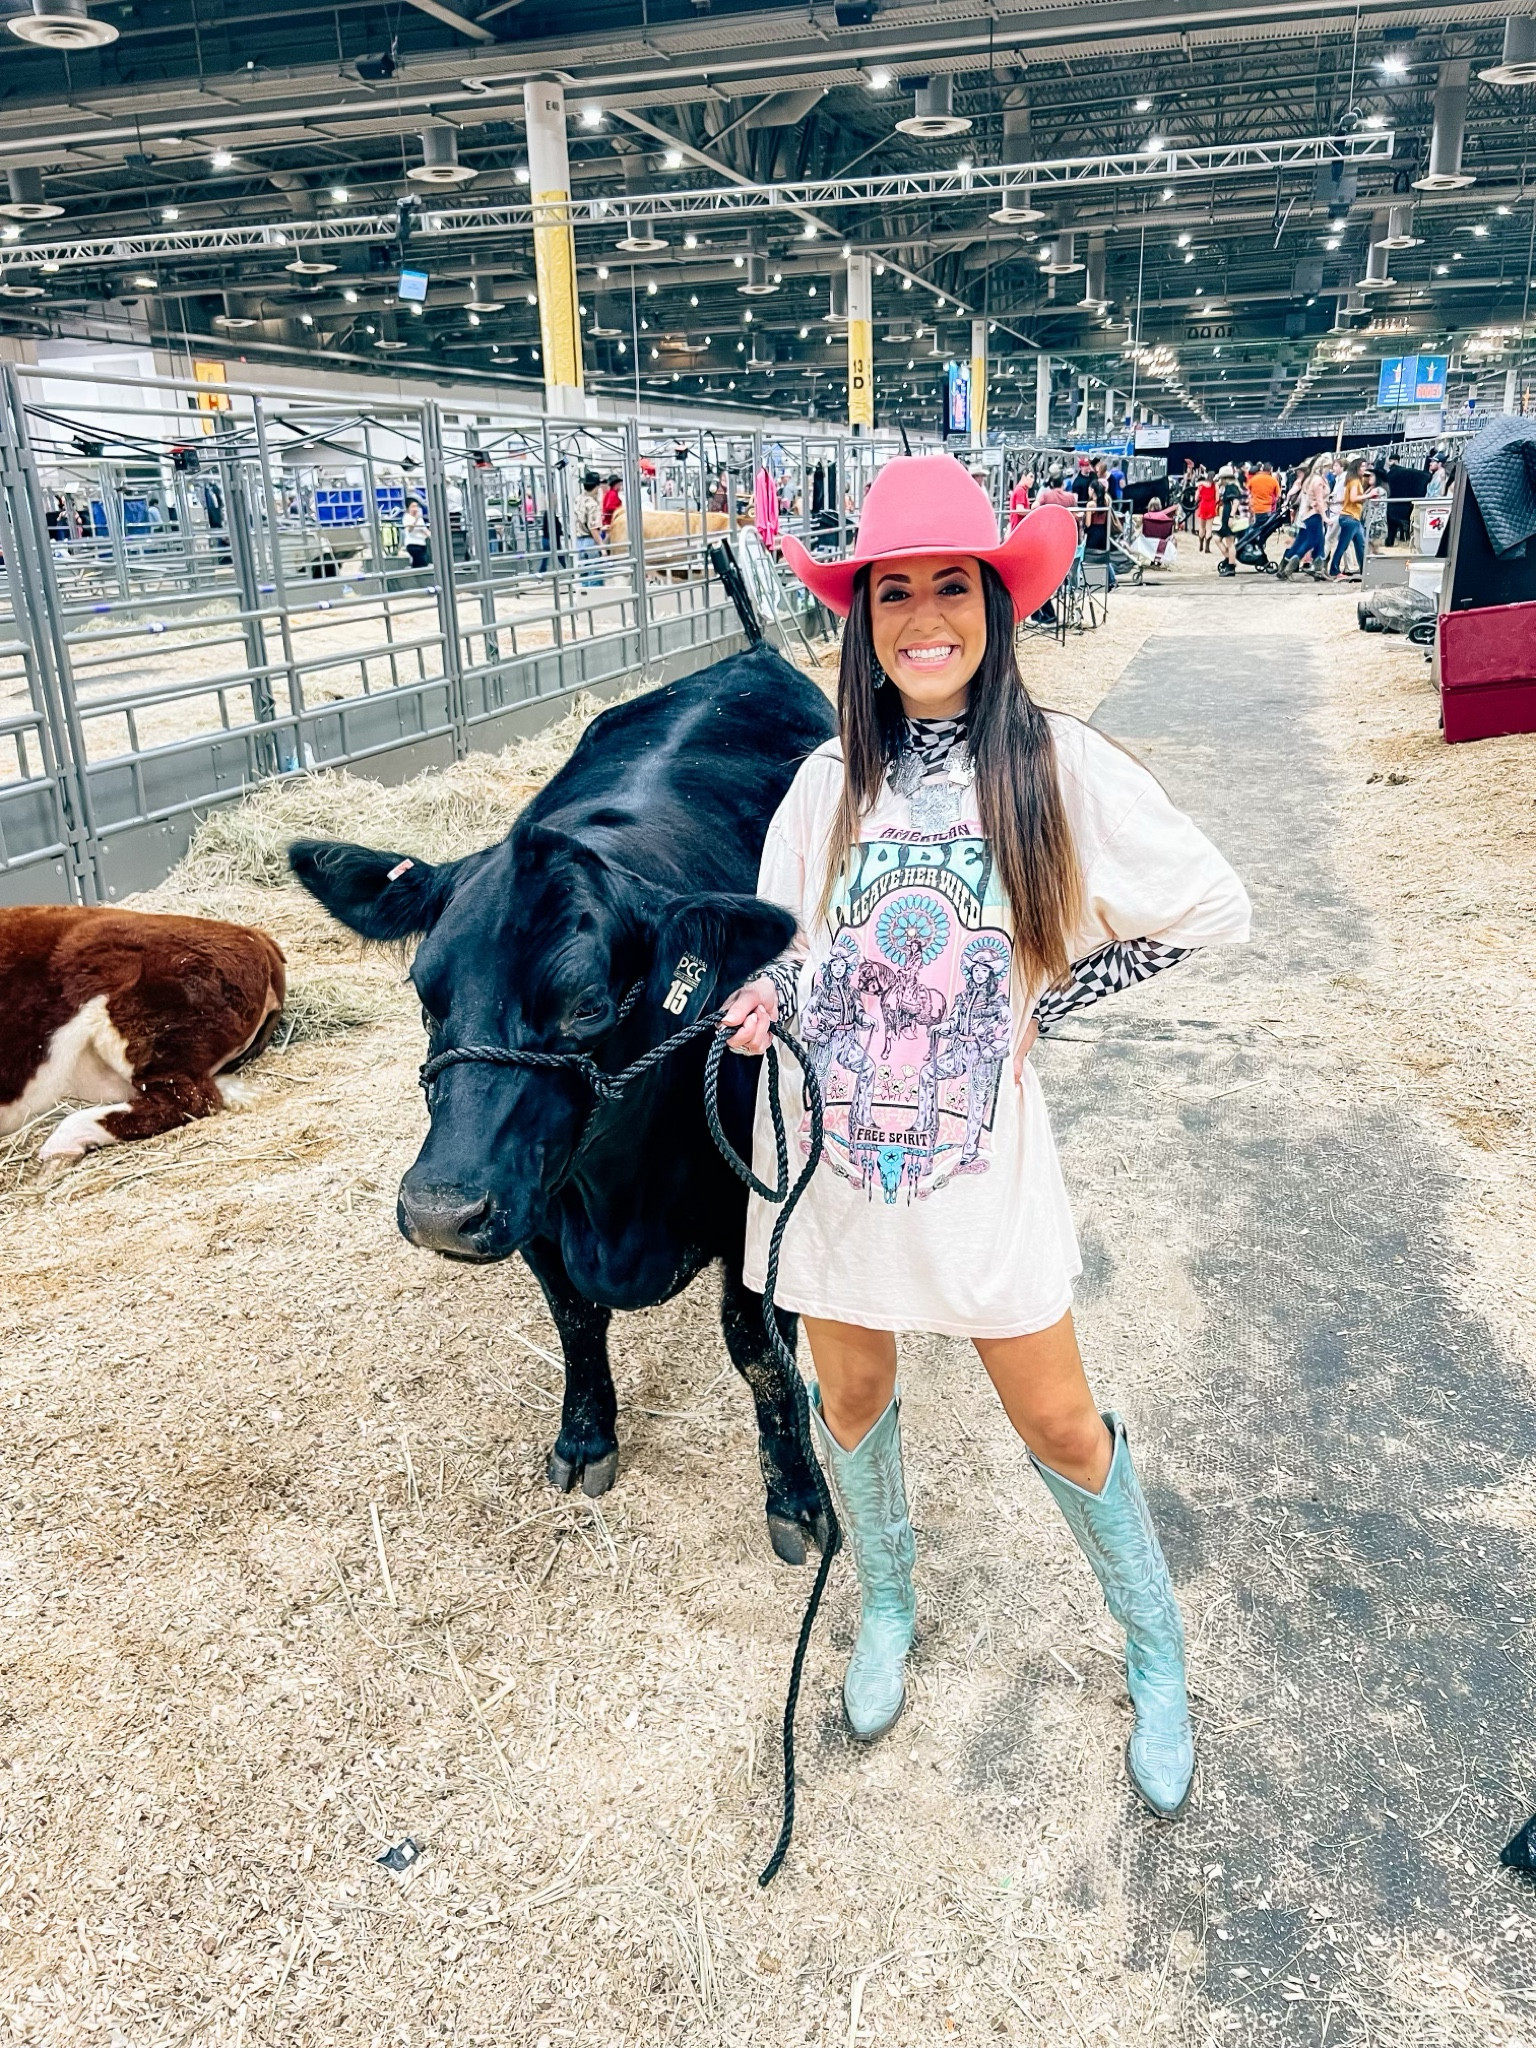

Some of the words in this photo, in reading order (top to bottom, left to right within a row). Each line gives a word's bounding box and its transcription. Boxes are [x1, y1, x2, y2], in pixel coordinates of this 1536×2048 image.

[853, 359, 863, 373] 13
[853, 376, 864, 389] D
[851, 869, 902, 926] LEAVE
[903, 866, 938, 887] HER
[939, 869, 982, 928] WILD
[676, 956, 707, 982] PCC
[662, 979, 694, 1016] 15
[856, 1128, 886, 1143] FREE
[889, 1132, 928, 1147] SPIRIT
